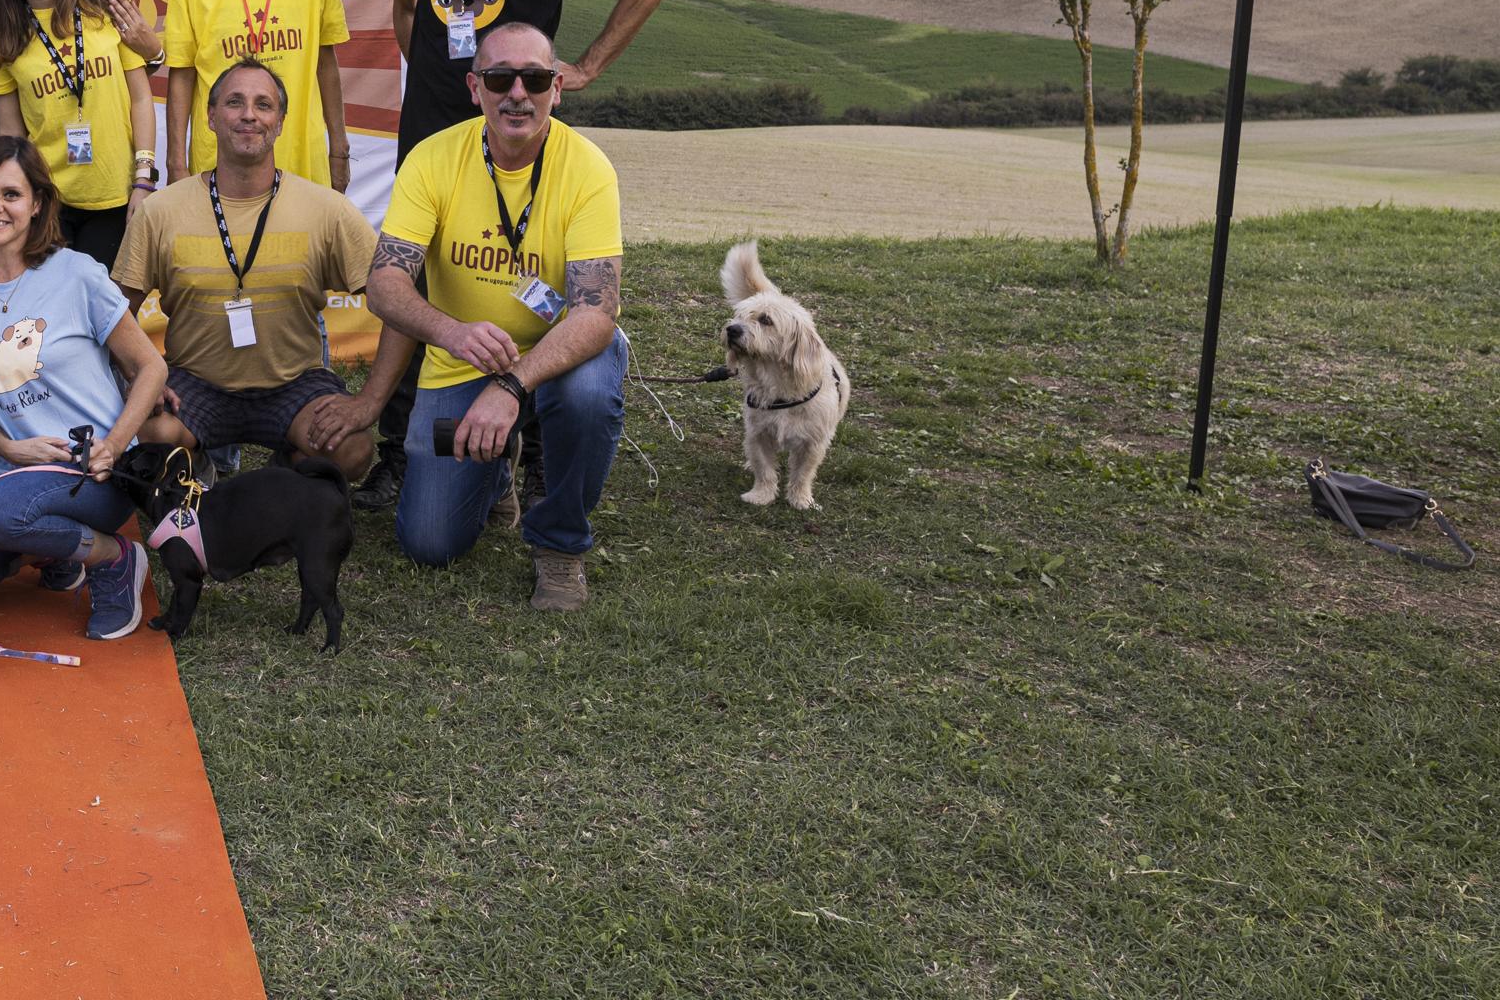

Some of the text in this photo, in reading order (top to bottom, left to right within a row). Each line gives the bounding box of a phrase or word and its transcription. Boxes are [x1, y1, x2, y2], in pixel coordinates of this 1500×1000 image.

[222, 29, 302, 59] UGOPIADI
[31, 56, 112, 99] UGOPADI
[451, 241, 541, 278] UGOPIAD
[327, 295, 362, 308] GN
[6, 403, 17, 414] to
[18, 388, 52, 408] Relax
